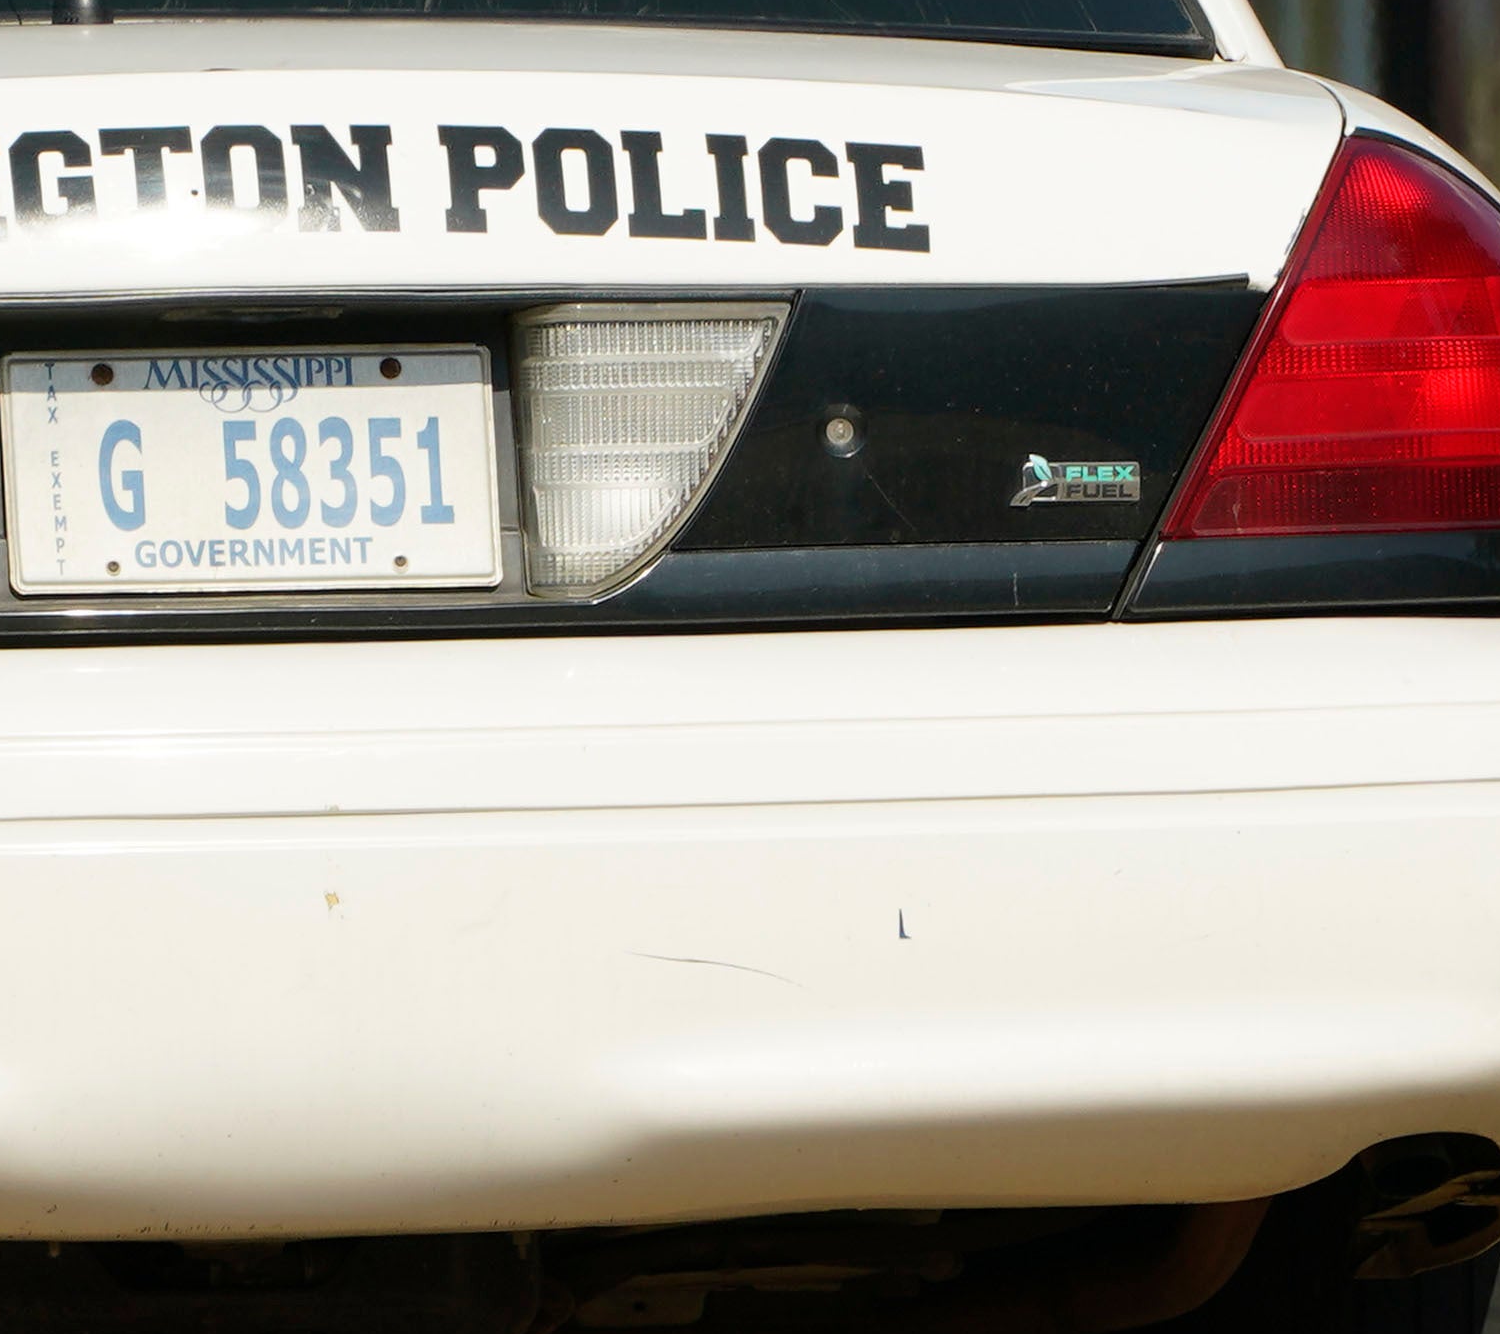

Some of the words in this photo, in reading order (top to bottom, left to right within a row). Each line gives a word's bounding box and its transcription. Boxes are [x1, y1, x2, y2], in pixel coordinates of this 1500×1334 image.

[438, 123, 931, 254] POLICE
[44, 362, 60, 425] TAX
[142, 357, 354, 408] MISSISSIPPI
[98, 418, 146, 532] G
[222, 416, 456, 529] 58351
[1065, 466, 1135, 482] FLEX
[1066, 483, 1133, 498] FUEL
[50, 451, 66, 576] EXEMPT
[134, 536, 373, 569] GOVERNMENT
